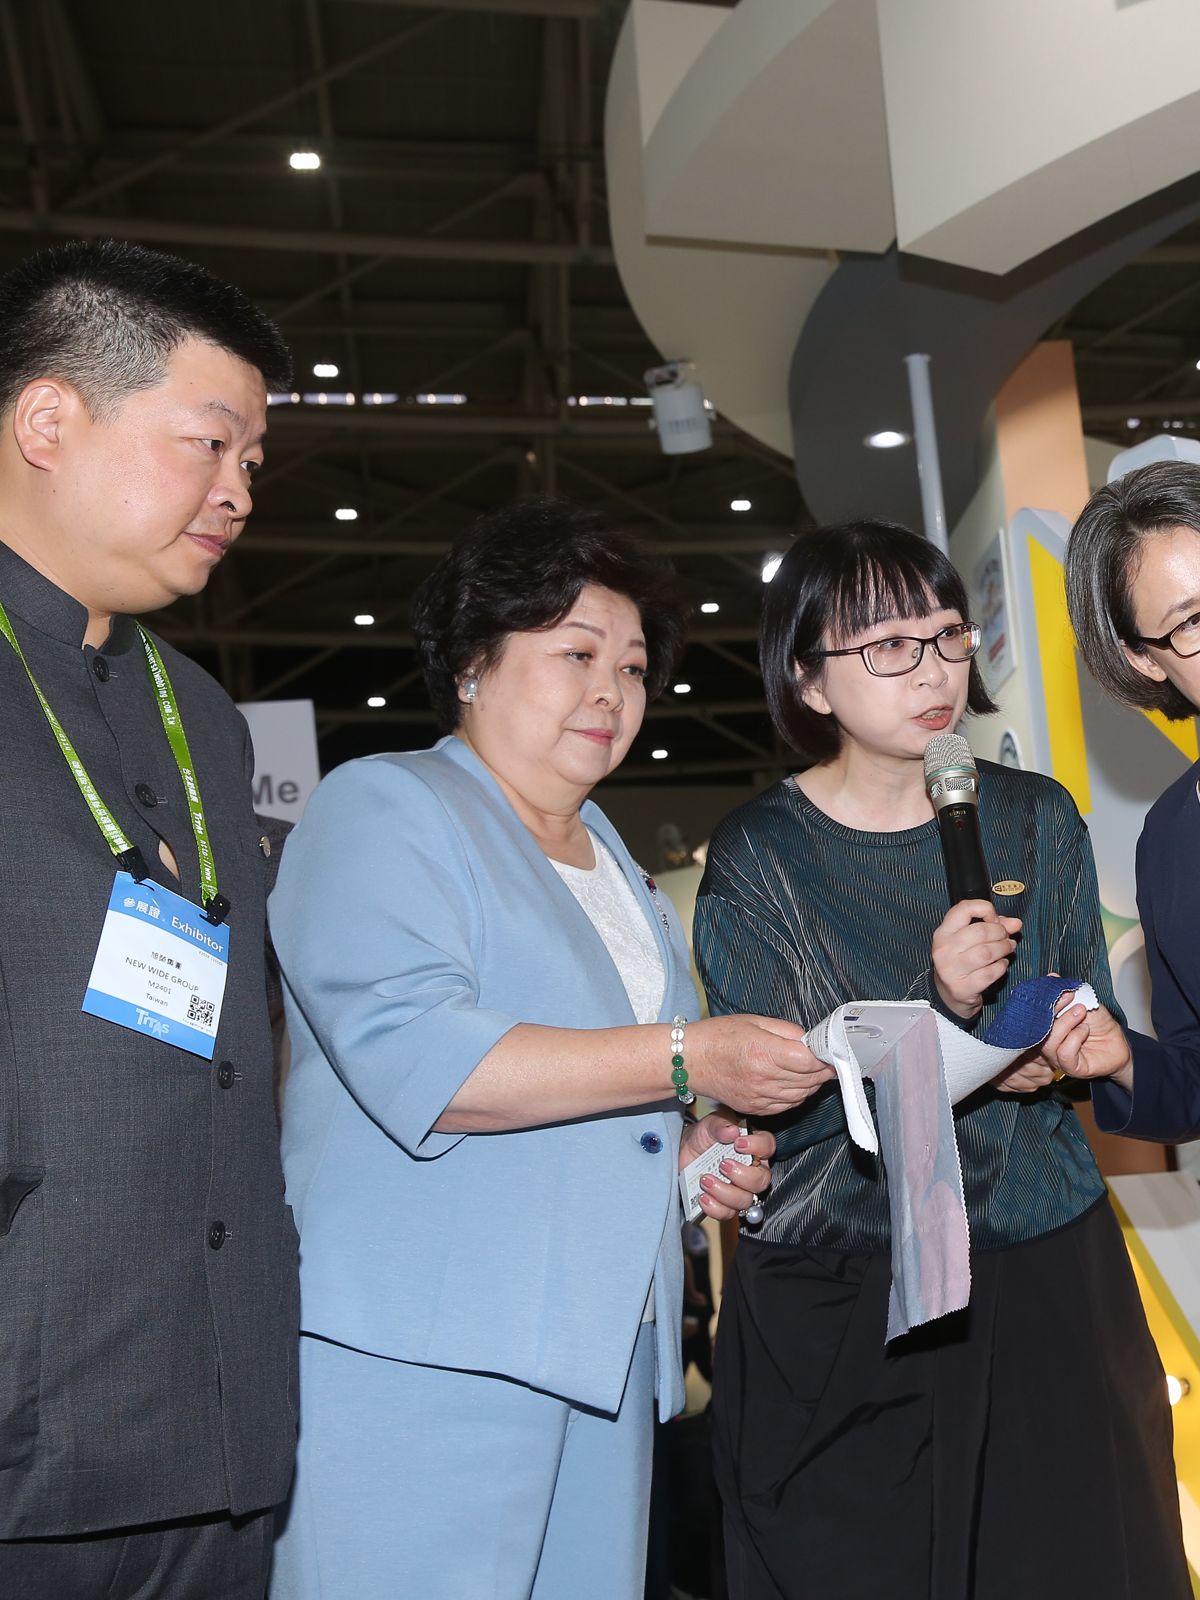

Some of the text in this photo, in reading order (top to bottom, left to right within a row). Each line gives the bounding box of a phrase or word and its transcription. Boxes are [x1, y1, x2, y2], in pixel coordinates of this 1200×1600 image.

[123, 896, 161, 920] 參展證
[171, 916, 224, 953] Exhibitor
[125, 956, 199, 992] NEW WIDE GROUP
[148, 979, 172, 995] M2401
[145, 993, 169, 1007] Taiwan
